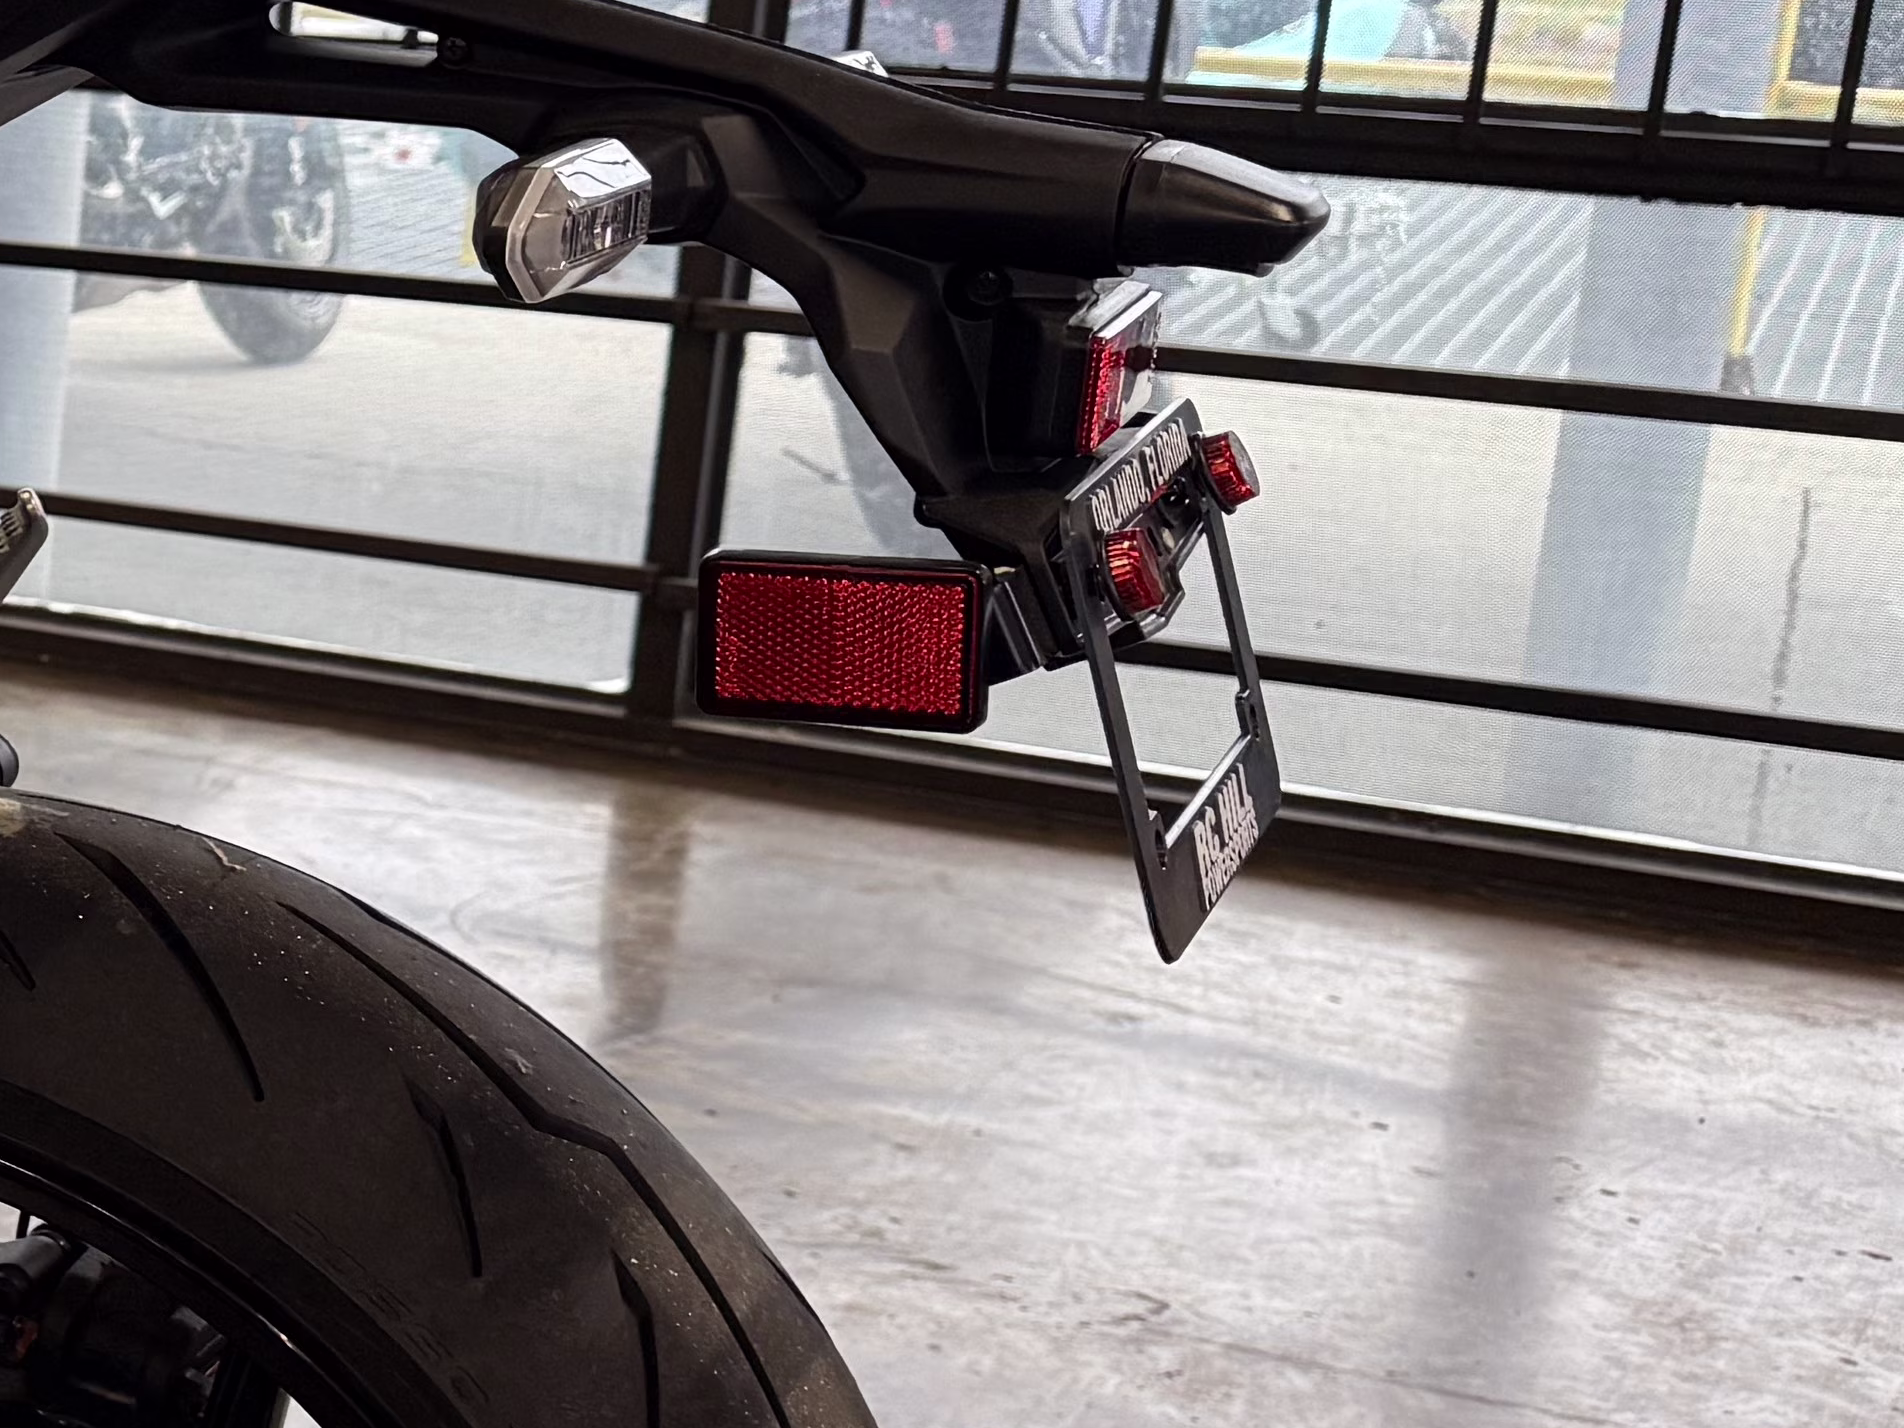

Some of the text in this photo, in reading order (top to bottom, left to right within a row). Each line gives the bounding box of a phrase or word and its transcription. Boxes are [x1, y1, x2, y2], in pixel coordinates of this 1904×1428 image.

[1142, 417, 1192, 491] FLORIDA
[1193, 762, 1253, 878] RC HILL
